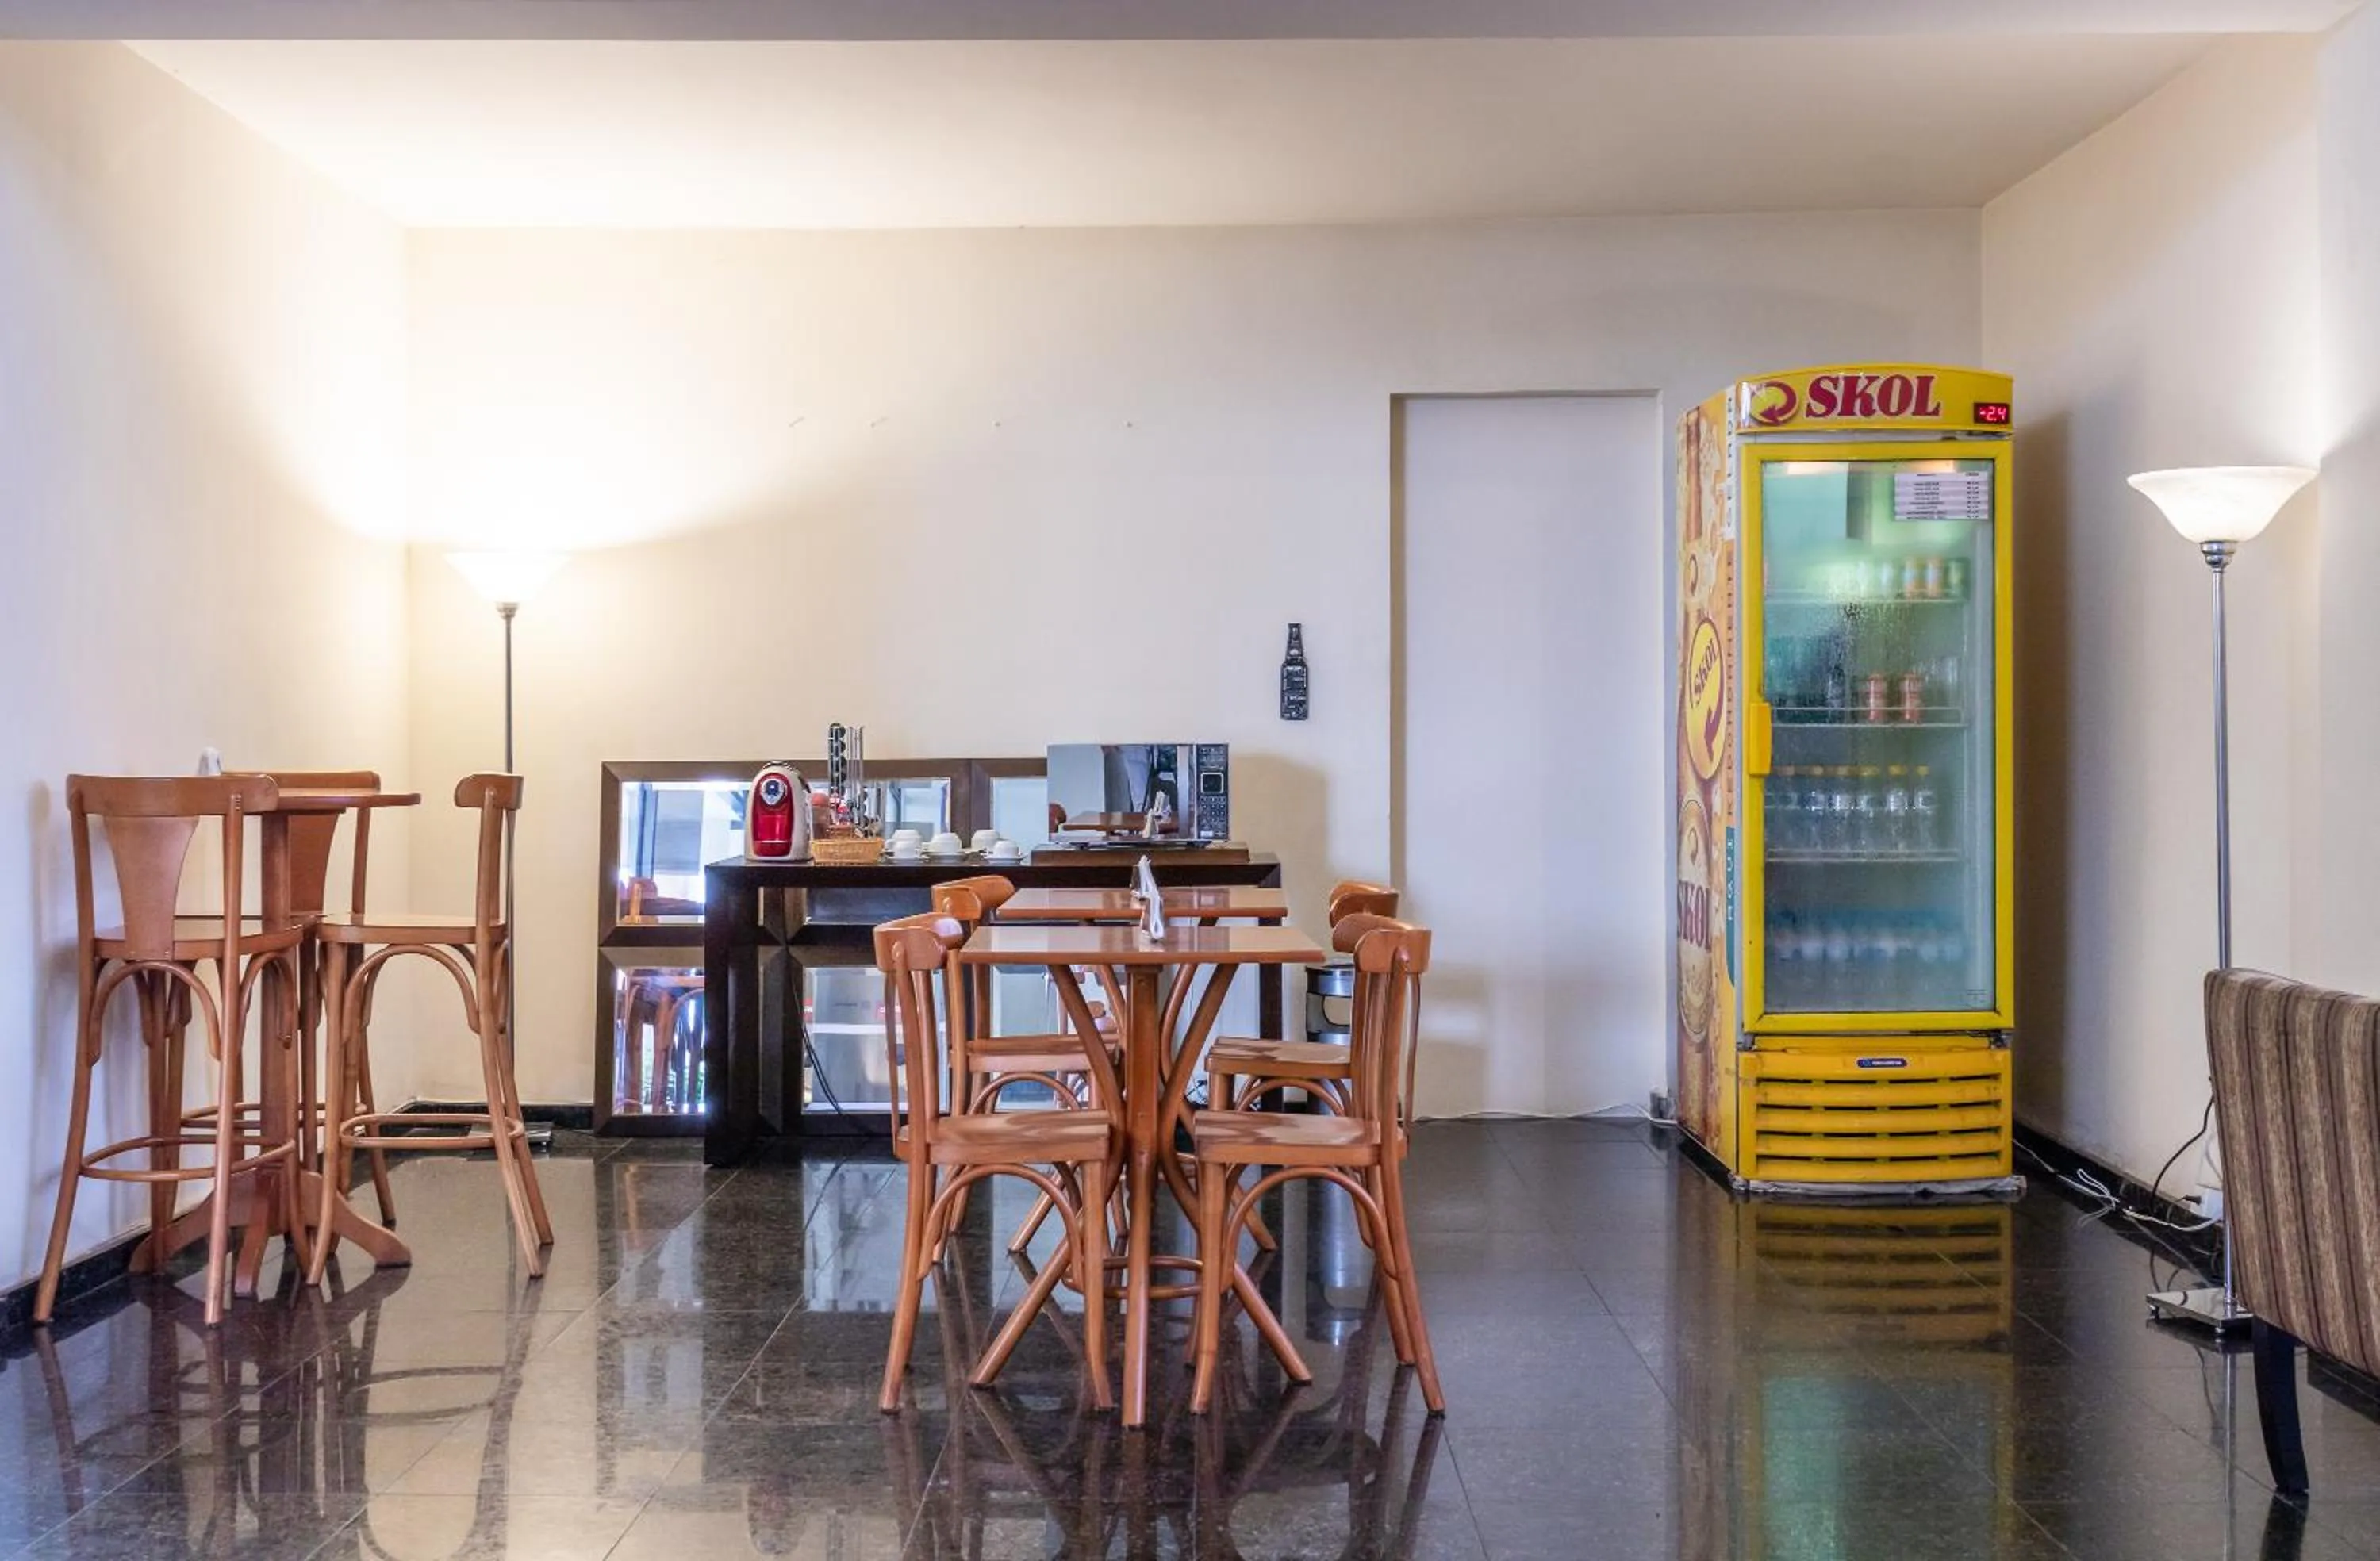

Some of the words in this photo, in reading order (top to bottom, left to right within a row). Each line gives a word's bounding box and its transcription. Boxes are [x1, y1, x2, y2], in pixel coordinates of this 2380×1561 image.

[1806, 375, 1940, 418] SKOL
[1694, 637, 1718, 704] SKOL
[1677, 880, 1712, 951] SKOL
